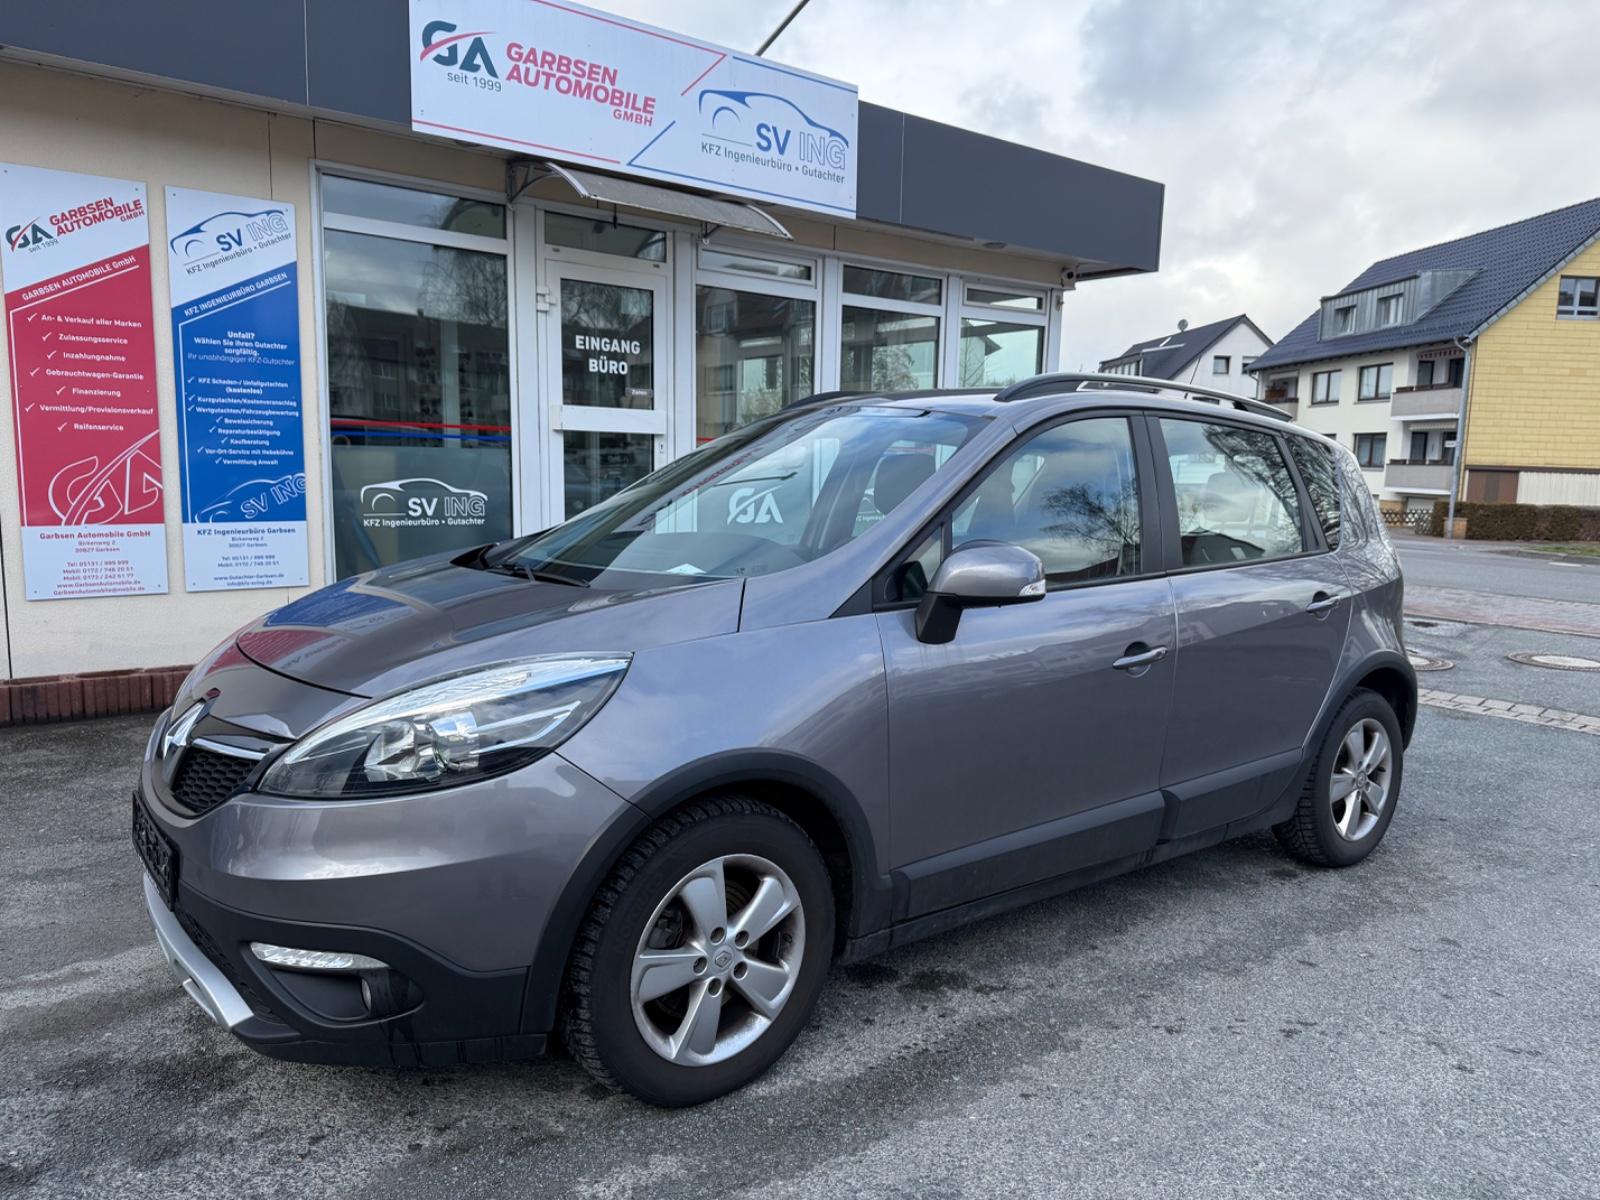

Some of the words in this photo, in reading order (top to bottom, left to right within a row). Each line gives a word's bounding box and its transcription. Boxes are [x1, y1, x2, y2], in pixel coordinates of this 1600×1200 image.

[506, 42, 618, 86] GARBSEN
[447, 72, 469, 85] seit
[473, 76, 502, 93] 1999
[506, 64, 657, 115] AUTOMOBILE
[613, 108, 653, 127] GMBH
[756, 122, 791, 156] SV
[800, 132, 846, 171] ING
[701, 142, 721, 156] KFZ
[724, 147, 792, 172] Ingenieurbüro
[802, 166, 845, 184] Gutachter
[49, 197, 114, 226] GARBSEN
[56, 199, 143, 237] AUTOMOBILE
[120, 209, 145, 223] GMBH
[216, 228, 243, 252] SV
[246, 213, 288, 242] ING
[28, 245, 41, 253] seit
[41, 239, 59, 250] 1999
[186, 265, 202, 275] KFZ
[203, 247, 253, 270] Ingenieurbüro
[258, 233, 291, 249] Gutachter
[22, 283, 62, 301] GARBSEN
[62, 264, 112, 288] AUTOMOBILE
[112, 255, 137, 269] GmbH
[184, 306, 200, 317] KFZ
[199, 285, 255, 311] INGENIEURBÜRO
[256, 272, 288, 289] GARBSEN
[64, 316, 94, 325] Verkauf
[95, 318, 112, 326] aller
[114, 320, 142, 328] Marken
[59, 333, 128, 345] Zulassungsservice
[194, 337, 222, 345] Wählen
[235, 339, 253, 347] Ihren
[254, 340, 287, 349] Gutachter
[227, 331, 255, 340] Unfall?
[224, 348, 260, 356] sorgfältig.
[575, 335, 641, 354] EINGANG
[63, 352, 126, 362] Inzahlungnahme
[198, 353, 247, 363] unabhängiger
[588, 356, 628, 375] BÜRO
[46, 368, 144, 380] Gebrauchtwagen-Garantie
[72, 388, 121, 397] Finanzierung
[40, 404, 153, 415] Vermittlung/Provisionsverkauf
[74, 423, 124, 431] Reifenservice
[240, 492, 269, 519] SV
[408, 497, 438, 517] SV
[444, 496, 485, 517] ING
[363, 519, 380, 527] KFZ
[382, 518, 440, 528] Ingenieurbüro
[77, 531, 125, 539] Automobile
[214, 527, 265, 537] Ingenieurbüro
